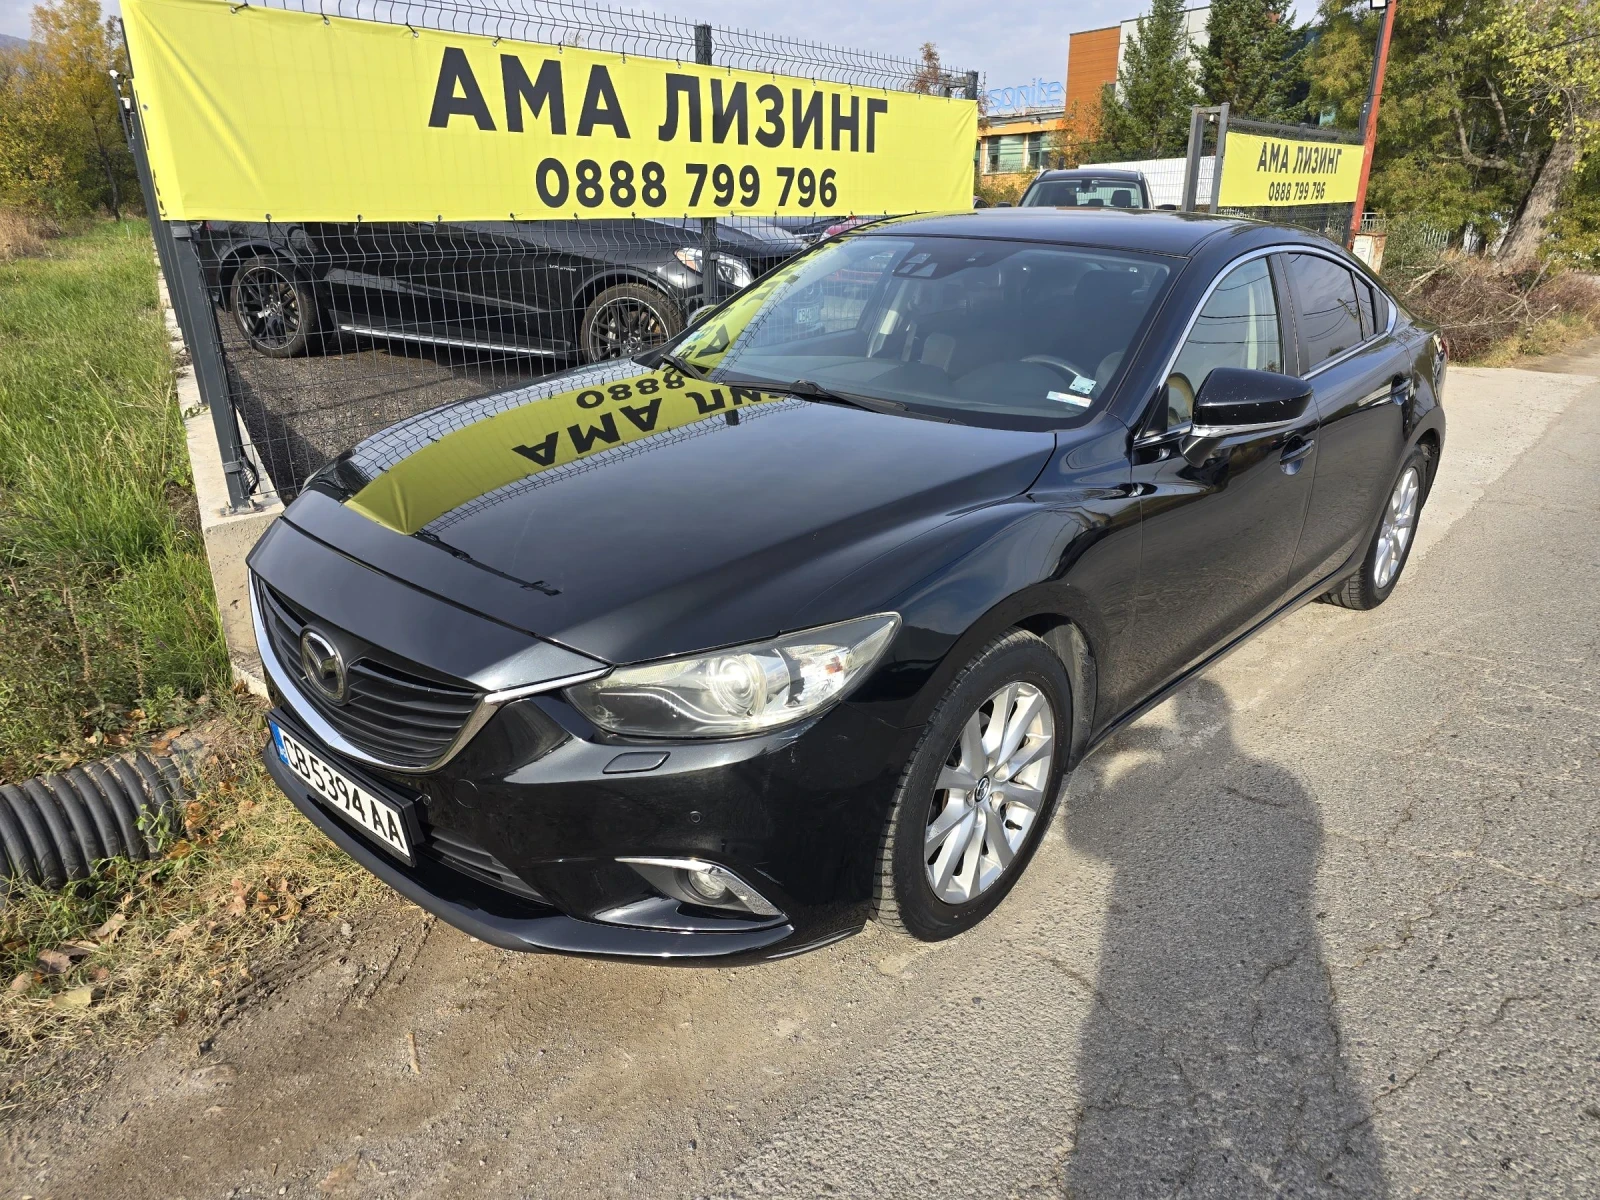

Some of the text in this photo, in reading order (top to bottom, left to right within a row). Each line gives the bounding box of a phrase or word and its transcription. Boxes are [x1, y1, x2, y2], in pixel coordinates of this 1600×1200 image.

[428, 46, 888, 153] АМА ЛИЗИНГ
[1256, 141, 1343, 175] АМА ЛИЗИНГ
[535, 157, 837, 209] 0888 799 796
[1268, 181, 1327, 202] 0888 799 796
